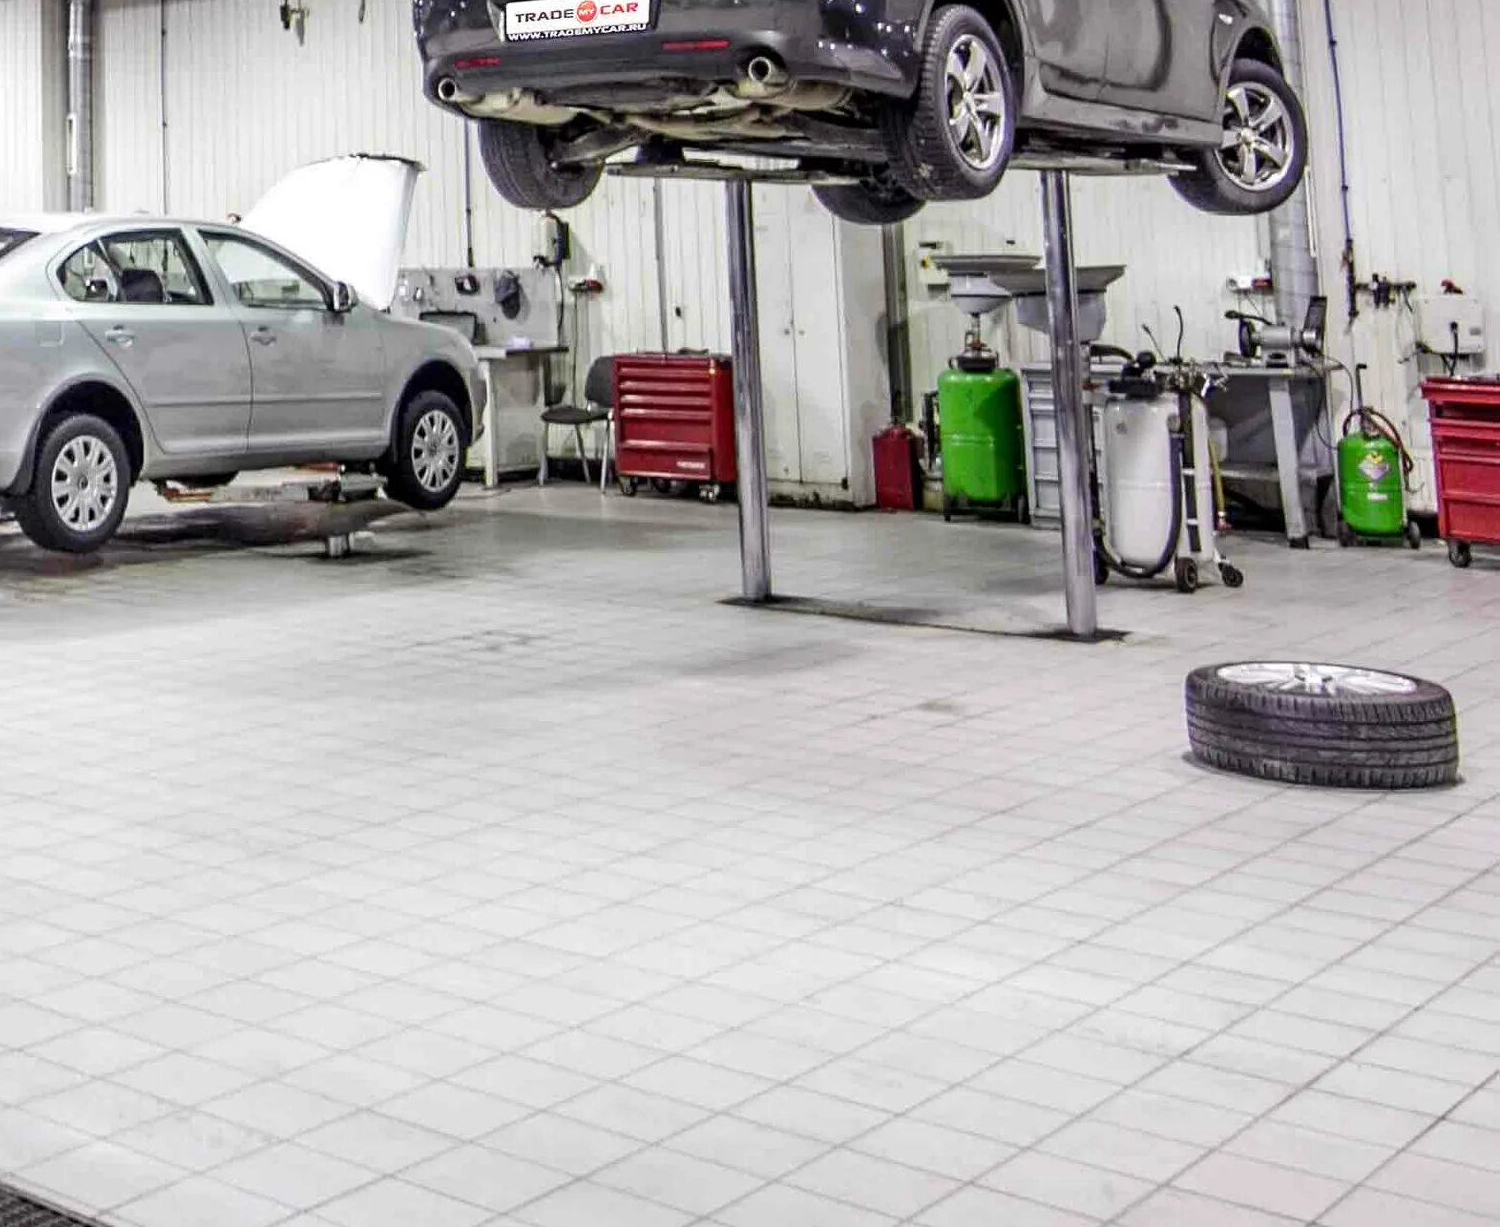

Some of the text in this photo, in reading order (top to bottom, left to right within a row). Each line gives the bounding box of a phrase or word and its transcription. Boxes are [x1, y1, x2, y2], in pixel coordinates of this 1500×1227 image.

[515, 2, 639, 24] TRADE MY CAR
[507, 23, 647, 41] WWW.TRADEMYCAR.RU
